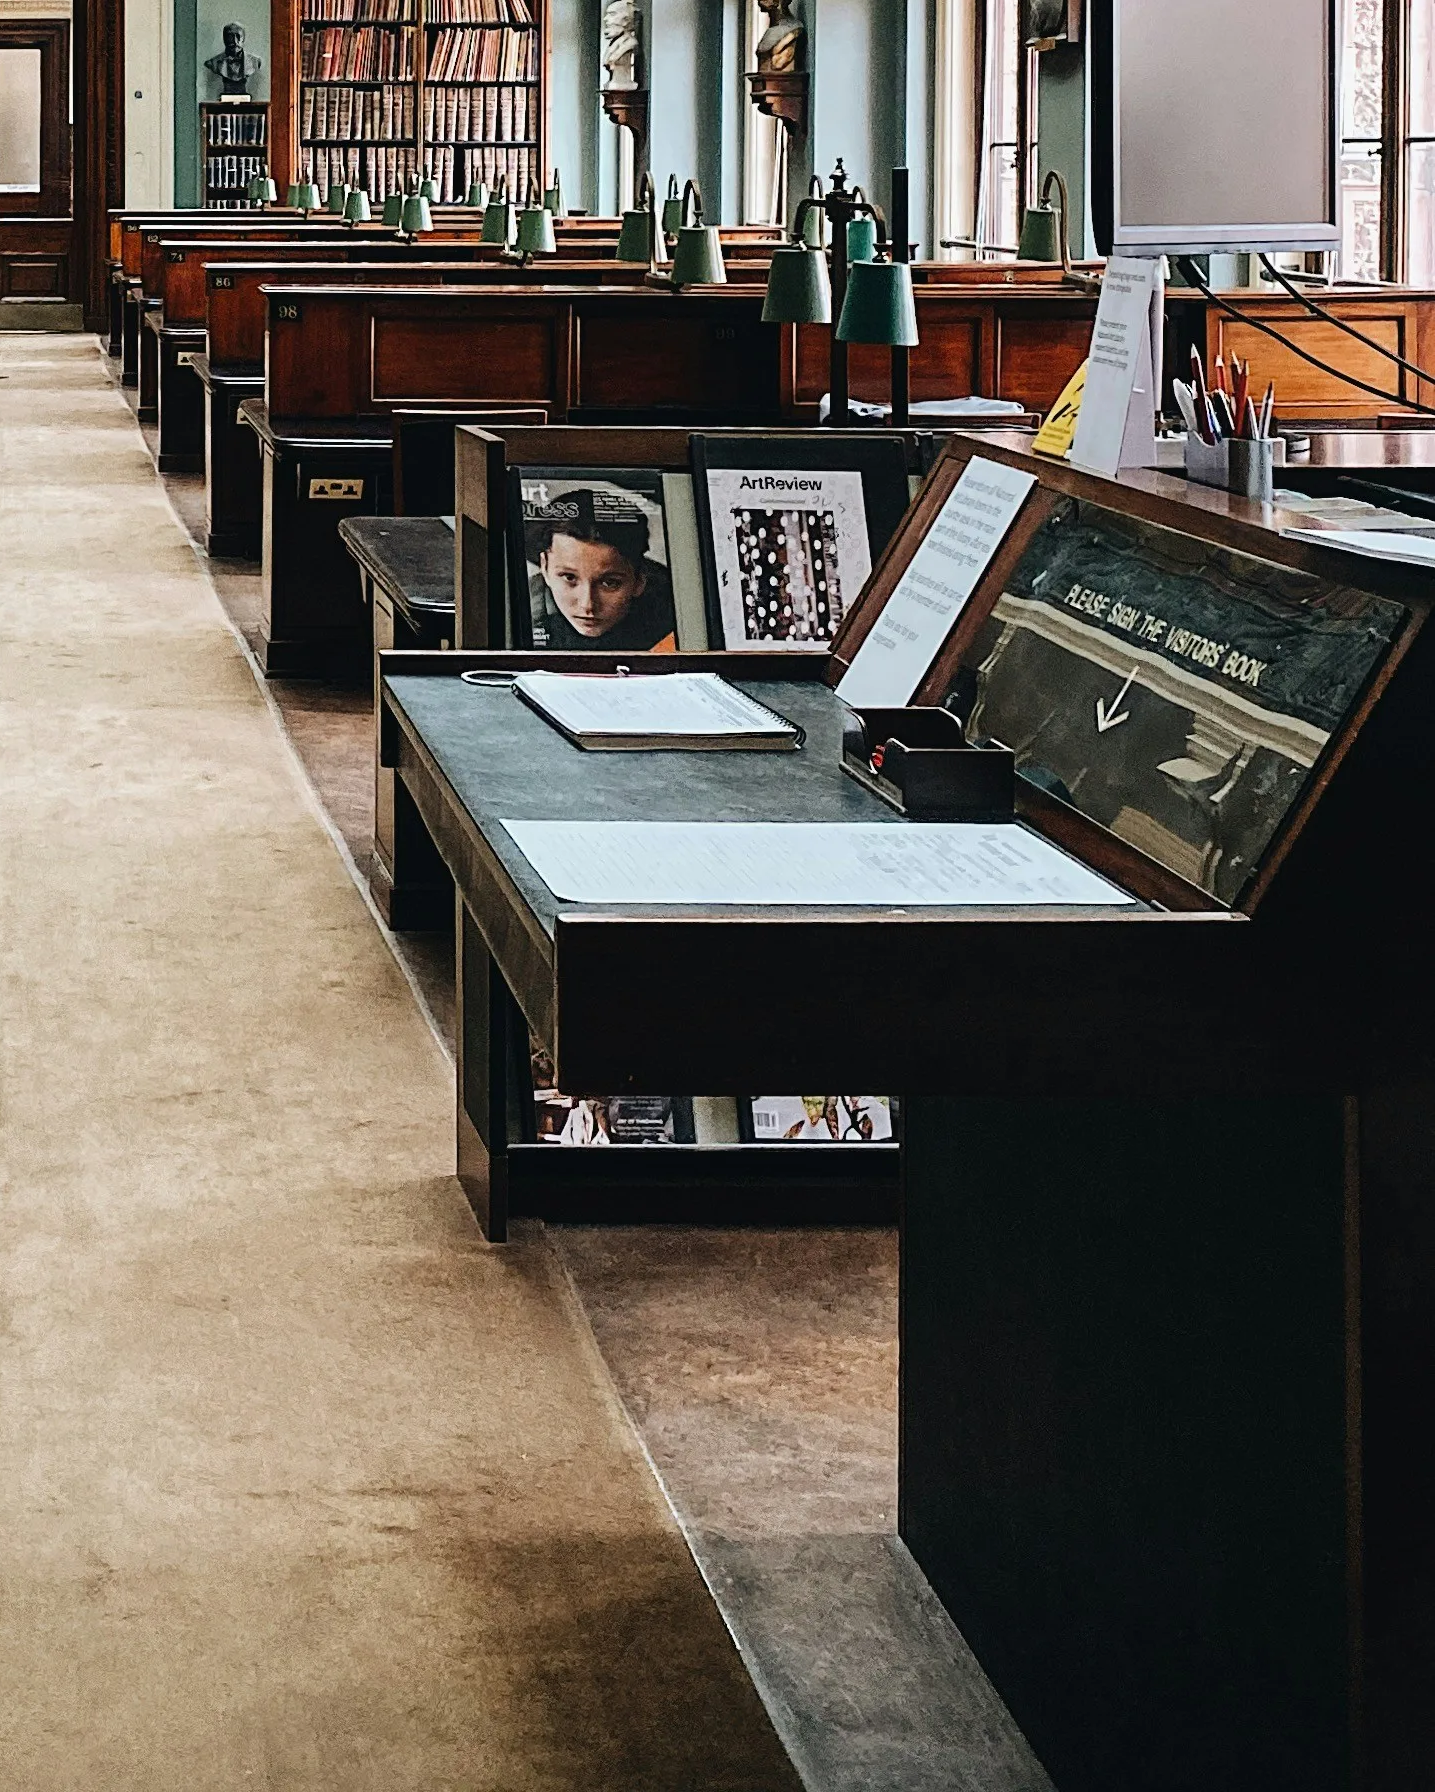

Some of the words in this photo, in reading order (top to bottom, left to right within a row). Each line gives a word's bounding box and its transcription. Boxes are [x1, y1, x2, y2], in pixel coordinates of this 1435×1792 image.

[170, 252, 184, 262] 74
[215, 277, 231, 287] 86
[278, 305, 298, 319] 98
[739, 475, 823, 491] ArtReview
[1063, 583, 1111, 619] PLEASE
[1106, 601, 1141, 632] SIGN
[1136, 614, 1168, 643] THE
[1220, 650, 1268, 687] BOOK
